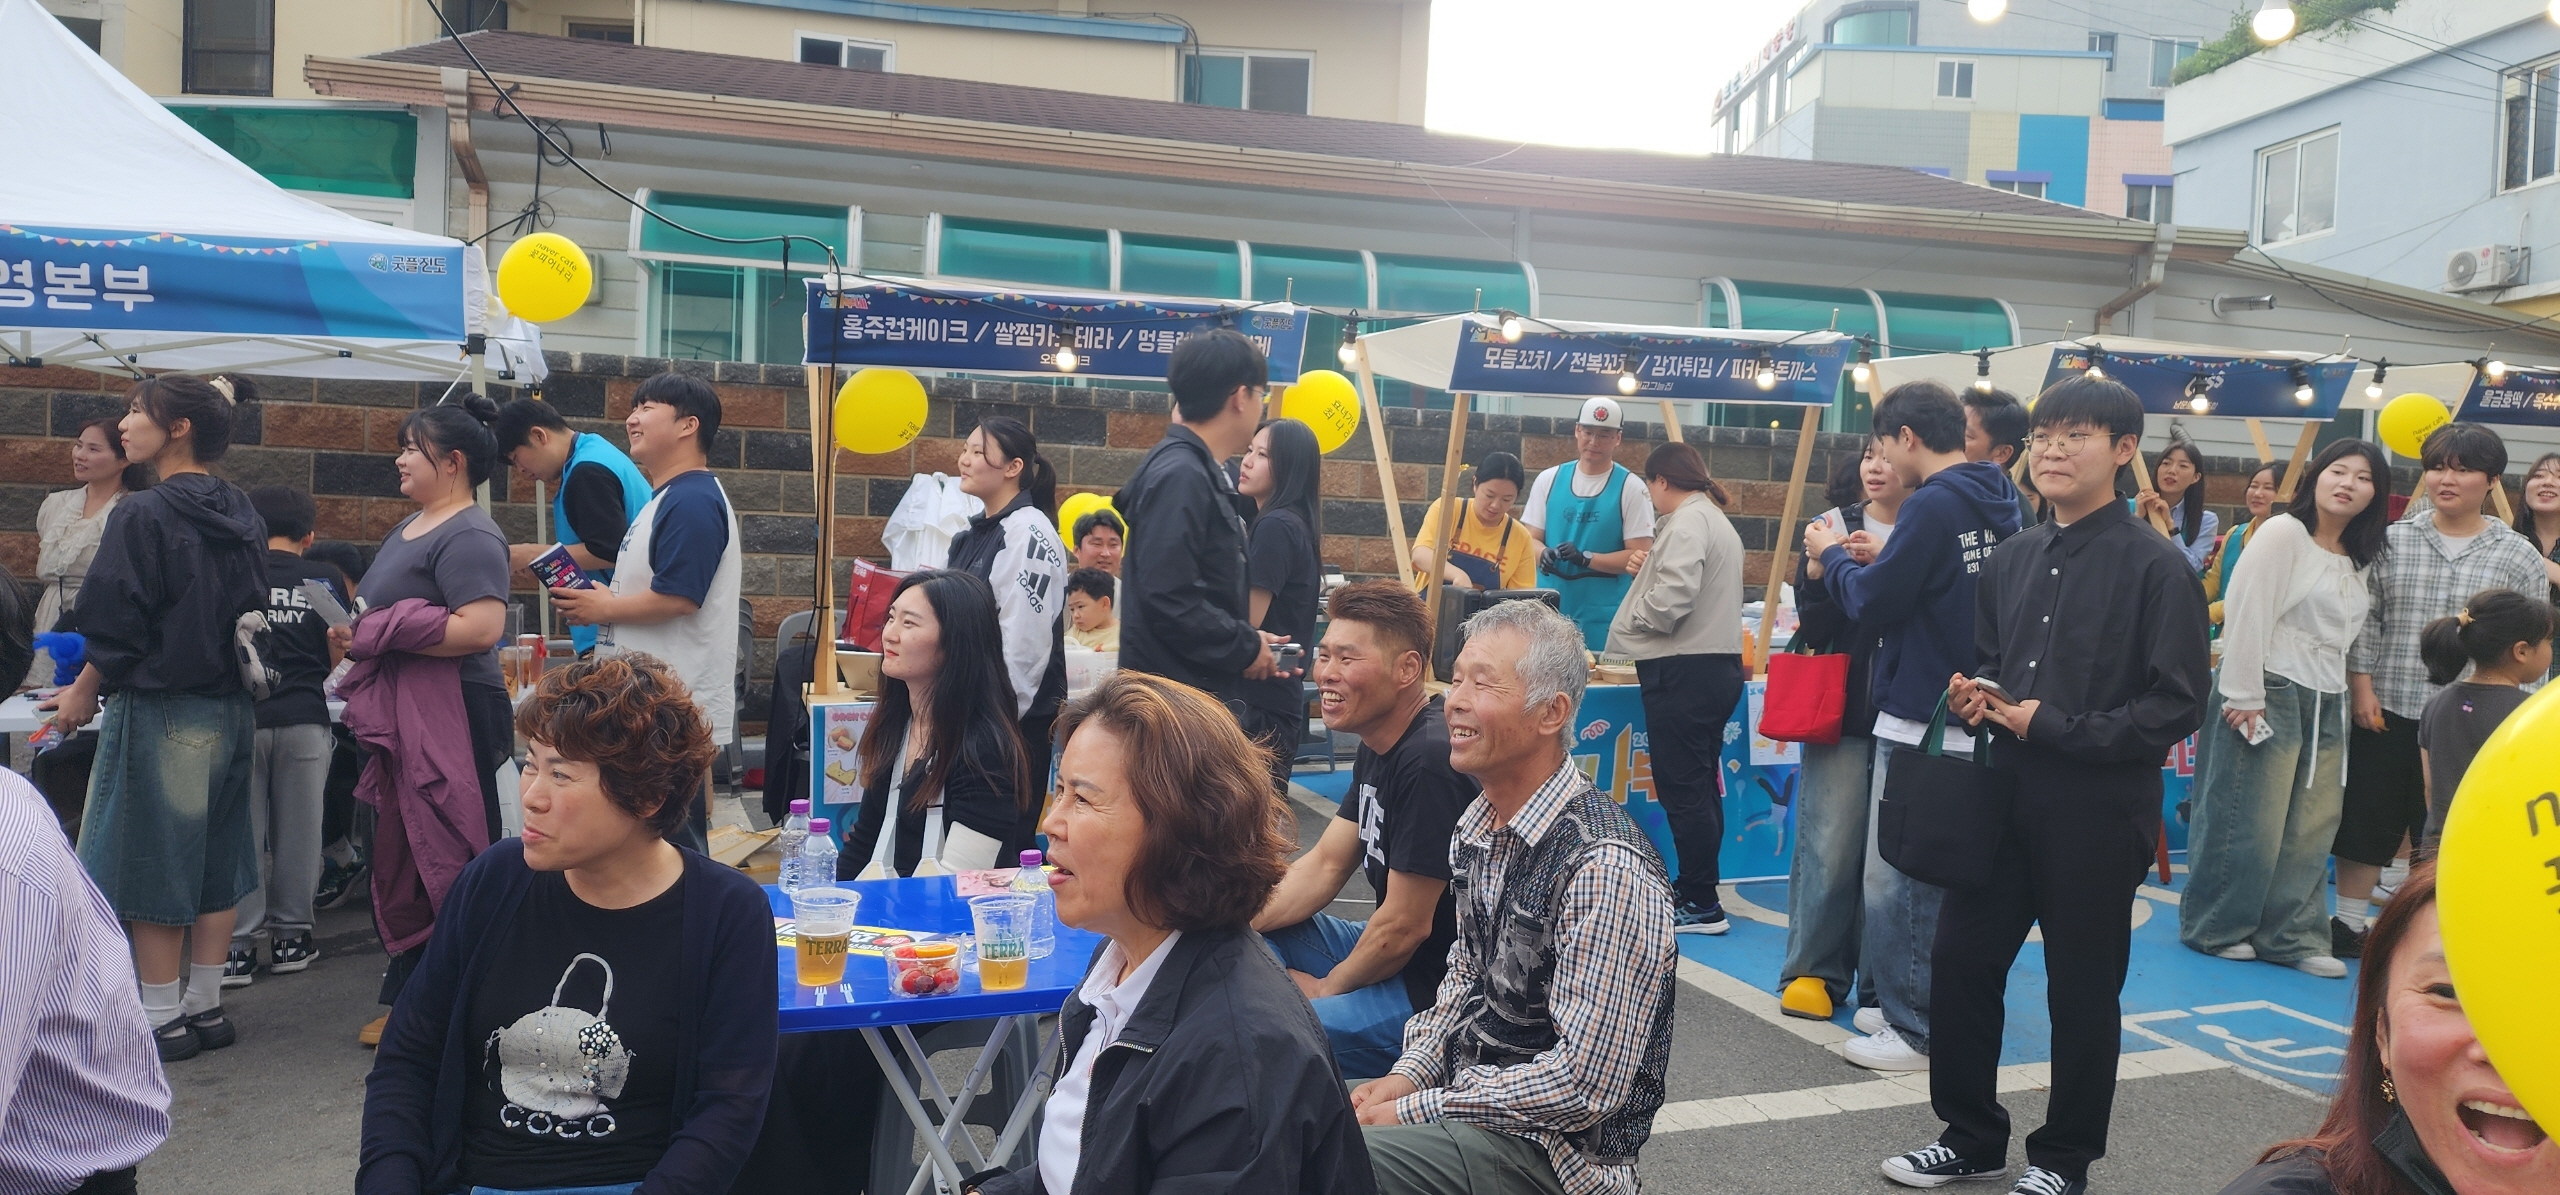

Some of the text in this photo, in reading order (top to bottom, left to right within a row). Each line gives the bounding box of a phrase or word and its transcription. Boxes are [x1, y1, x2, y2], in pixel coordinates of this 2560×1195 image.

[535, 243, 560, 257] naver
[391, 255, 447, 275] 굿플진도
[0, 259, 155, 312] 영본부
[842, 314, 969, 343] 홍주컵케이크
[994, 321, 1114, 350] 쌀찜카테라
[1483, 347, 1552, 371] 모듬꼬치
[1651, 355, 1713, 378] 감자튀김
[1730, 358, 1818, 381] 피카돈까스
[1028, 524, 1061, 568] adidas
[1958, 530, 1979, 549] THE
[1963, 548, 1982, 562] HOME
[267, 609, 305, 624] RMY
[806, 938, 848, 956] TERRA
[982, 939, 1025, 959] TERRA
